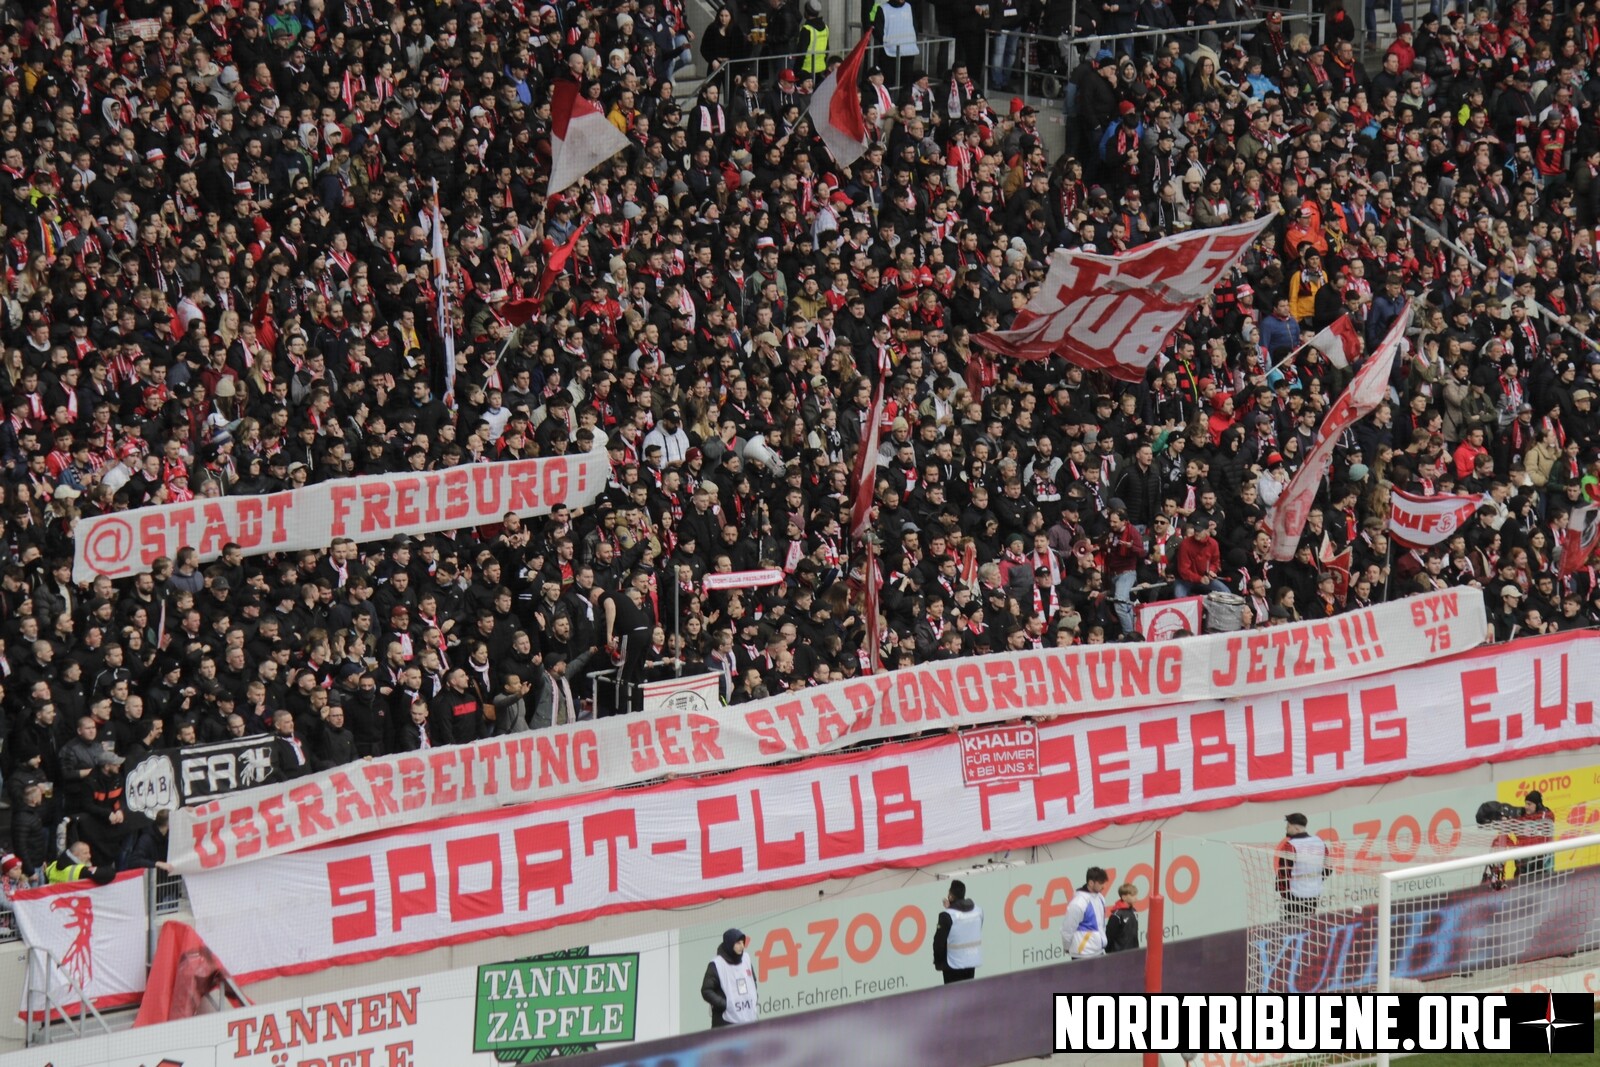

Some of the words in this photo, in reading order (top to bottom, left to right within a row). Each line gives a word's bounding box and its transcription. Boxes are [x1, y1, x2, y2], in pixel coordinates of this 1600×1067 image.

[83, 491, 295, 575] @STADT
[331, 456, 587, 537] FREIBURG:
[1410, 592, 1459, 628] SYN
[192, 729, 601, 870] ÜBERARBEITUNG
[627, 711, 726, 773] DER
[744, 645, 1184, 755] STADIONORDNUNG
[1212, 610, 1386, 687] JETZT!!!
[964, 731, 1034, 752] KHALID
[966, 752, 991, 766] FÜR
[993, 749, 1035, 762] IMMER
[129, 775, 168, 798] ACAB
[977, 767, 995, 777] BEI
[998, 762, 1026, 774] UNS
[1532, 775, 1571, 793] LOTTO
[328, 765, 924, 945] SPORT-CLUB
[744, 904, 927, 983] AZOO
[484, 961, 632, 1001] TANNEN
[756, 994, 794, 1015] nden.
[797, 985, 852, 1007] Fahren.
[854, 974, 909, 997] Freuen.
[227, 987, 421, 1059] TANNEN
[487, 1001, 624, 1043] ZÄPFLE
